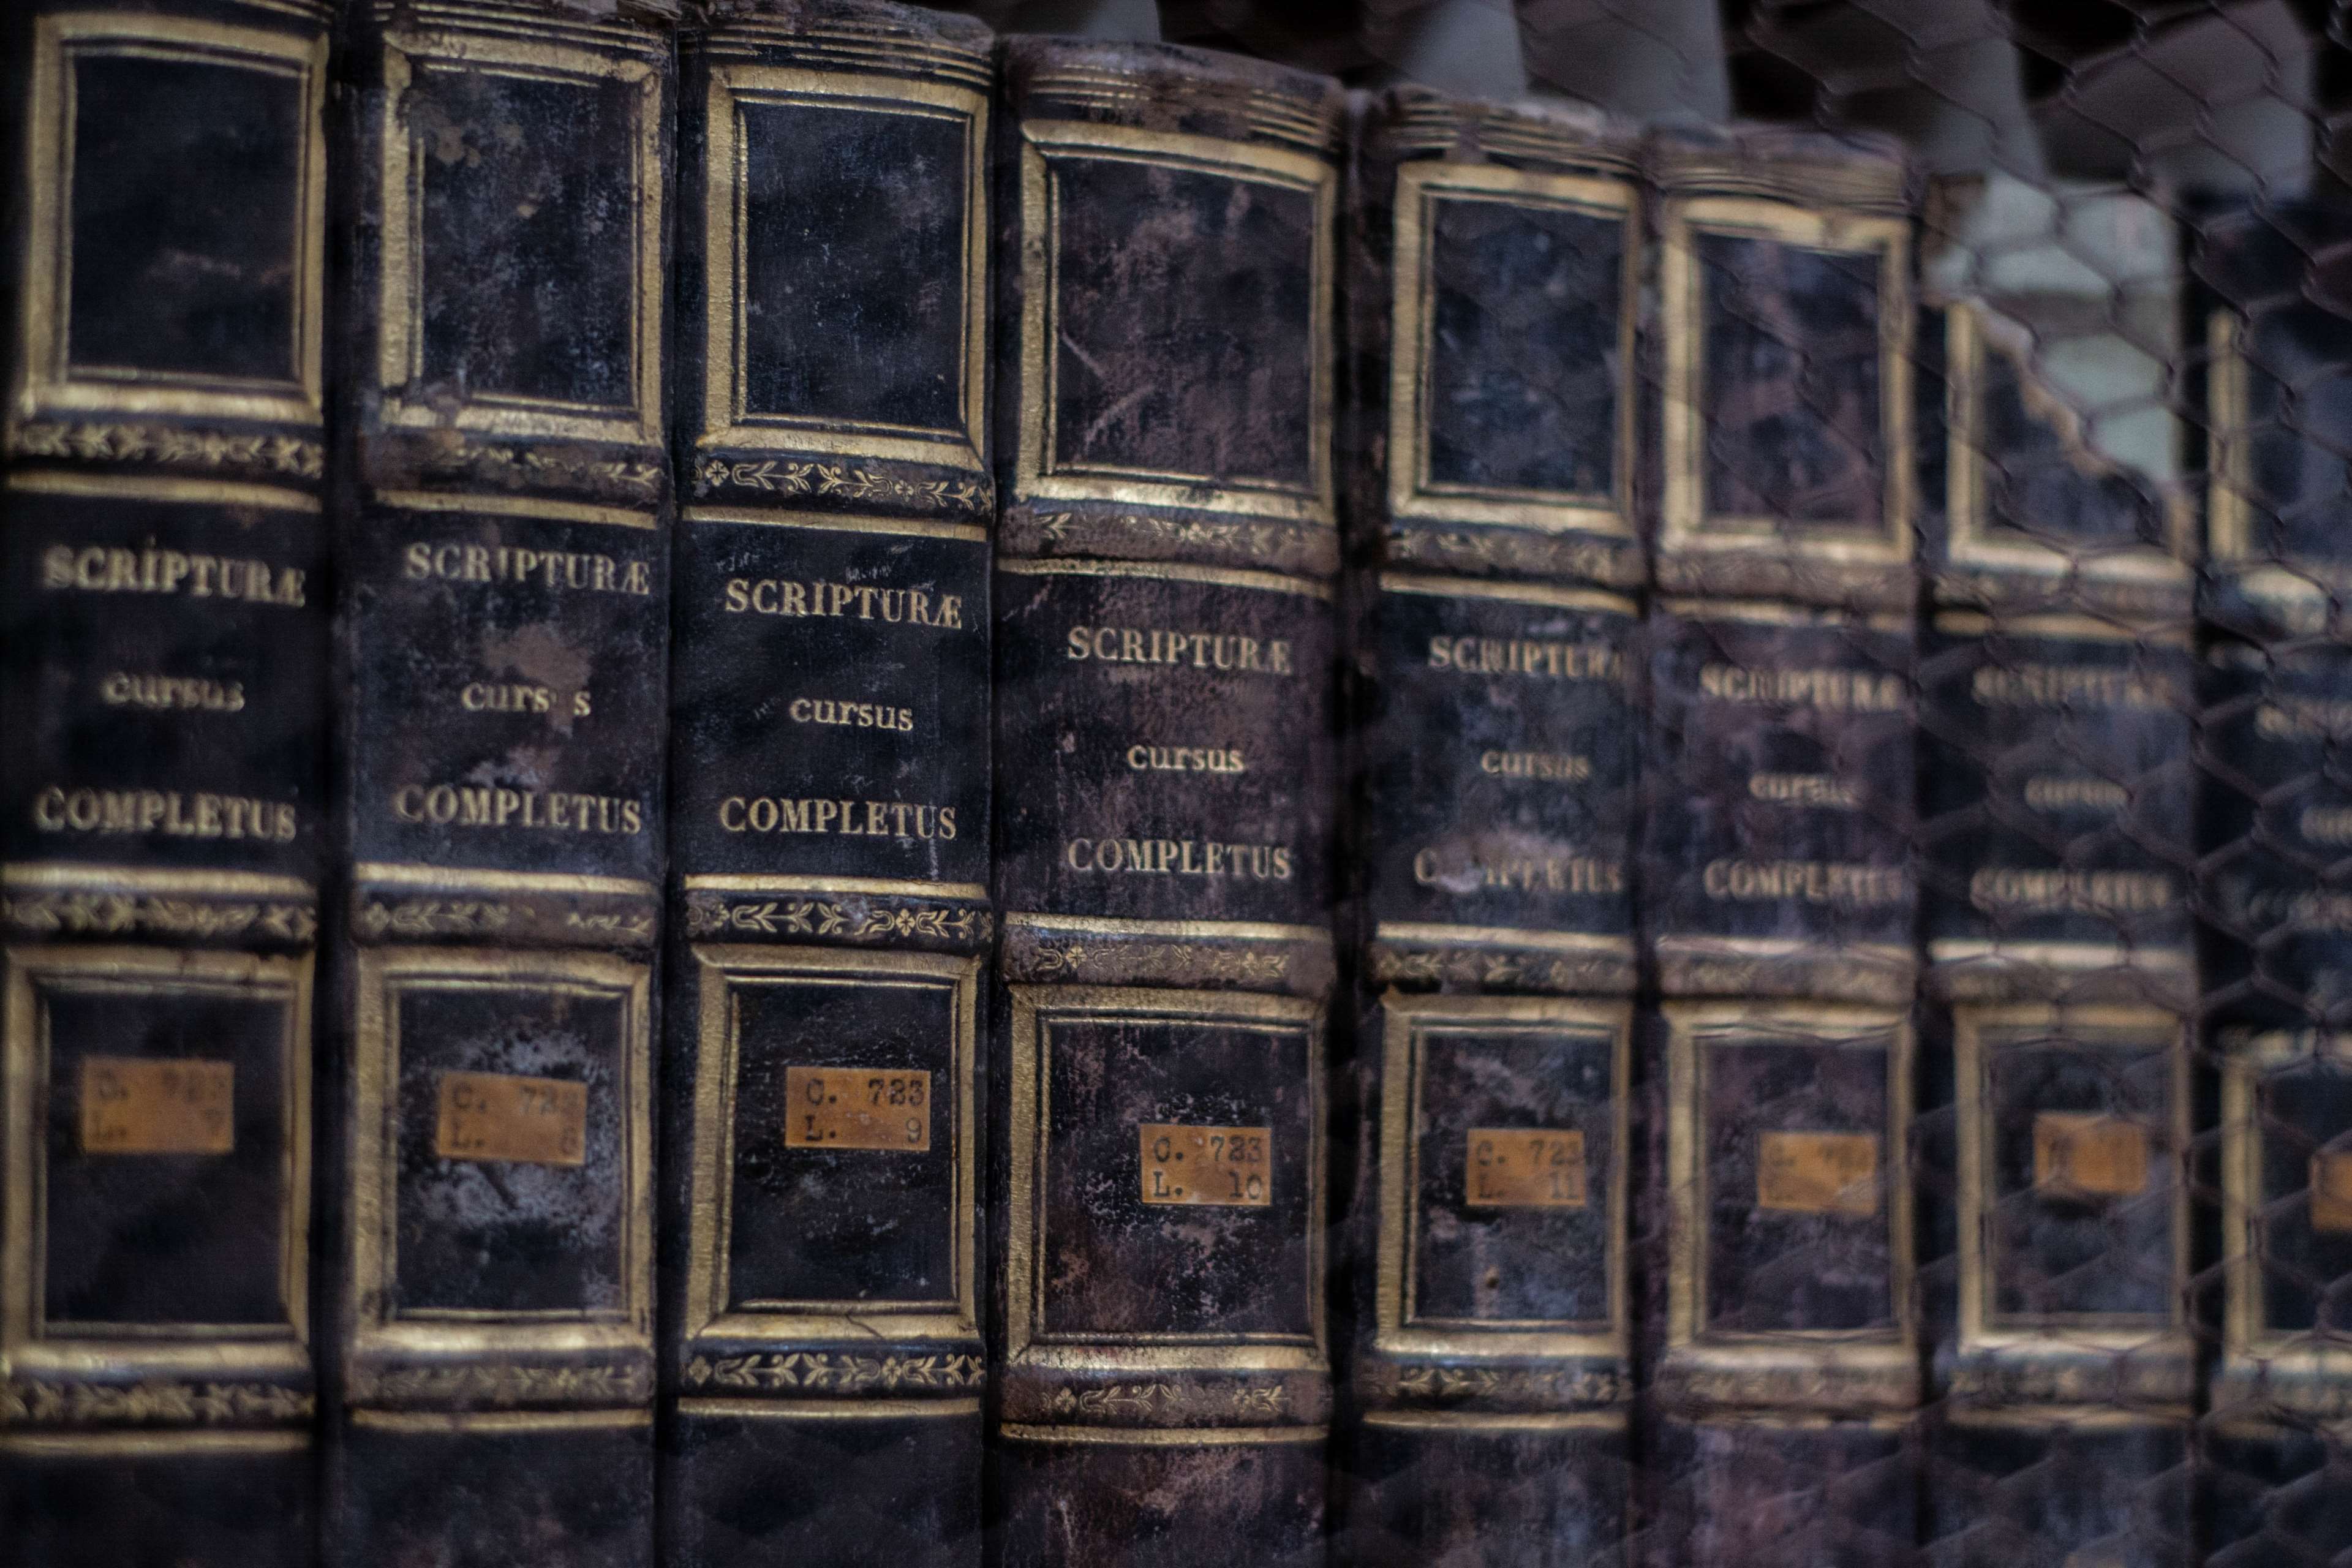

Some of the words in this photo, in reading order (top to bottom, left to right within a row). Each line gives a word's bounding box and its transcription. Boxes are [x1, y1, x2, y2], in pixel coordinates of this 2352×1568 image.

[405, 542, 650, 595] SCRIPTURÆ
[725, 579, 962, 629] SCRIPTURÆ
[1067, 625, 1291, 674] SCRIPTURÆ
[100, 673, 245, 711] cursus
[461, 682, 591, 716] curss
[788, 699, 913, 732] cursus
[1127, 745, 1245, 772] cursus
[34, 786, 296, 843] COMPLETUS
[394, 783, 642, 835] COMPLETUS
[720, 797, 957, 840] COMPLETUS
[1068, 838, 1293, 880] COMPLETUS
[1153, 1171, 1183, 1197] L.
[1229, 1171, 1262, 1200] 10
